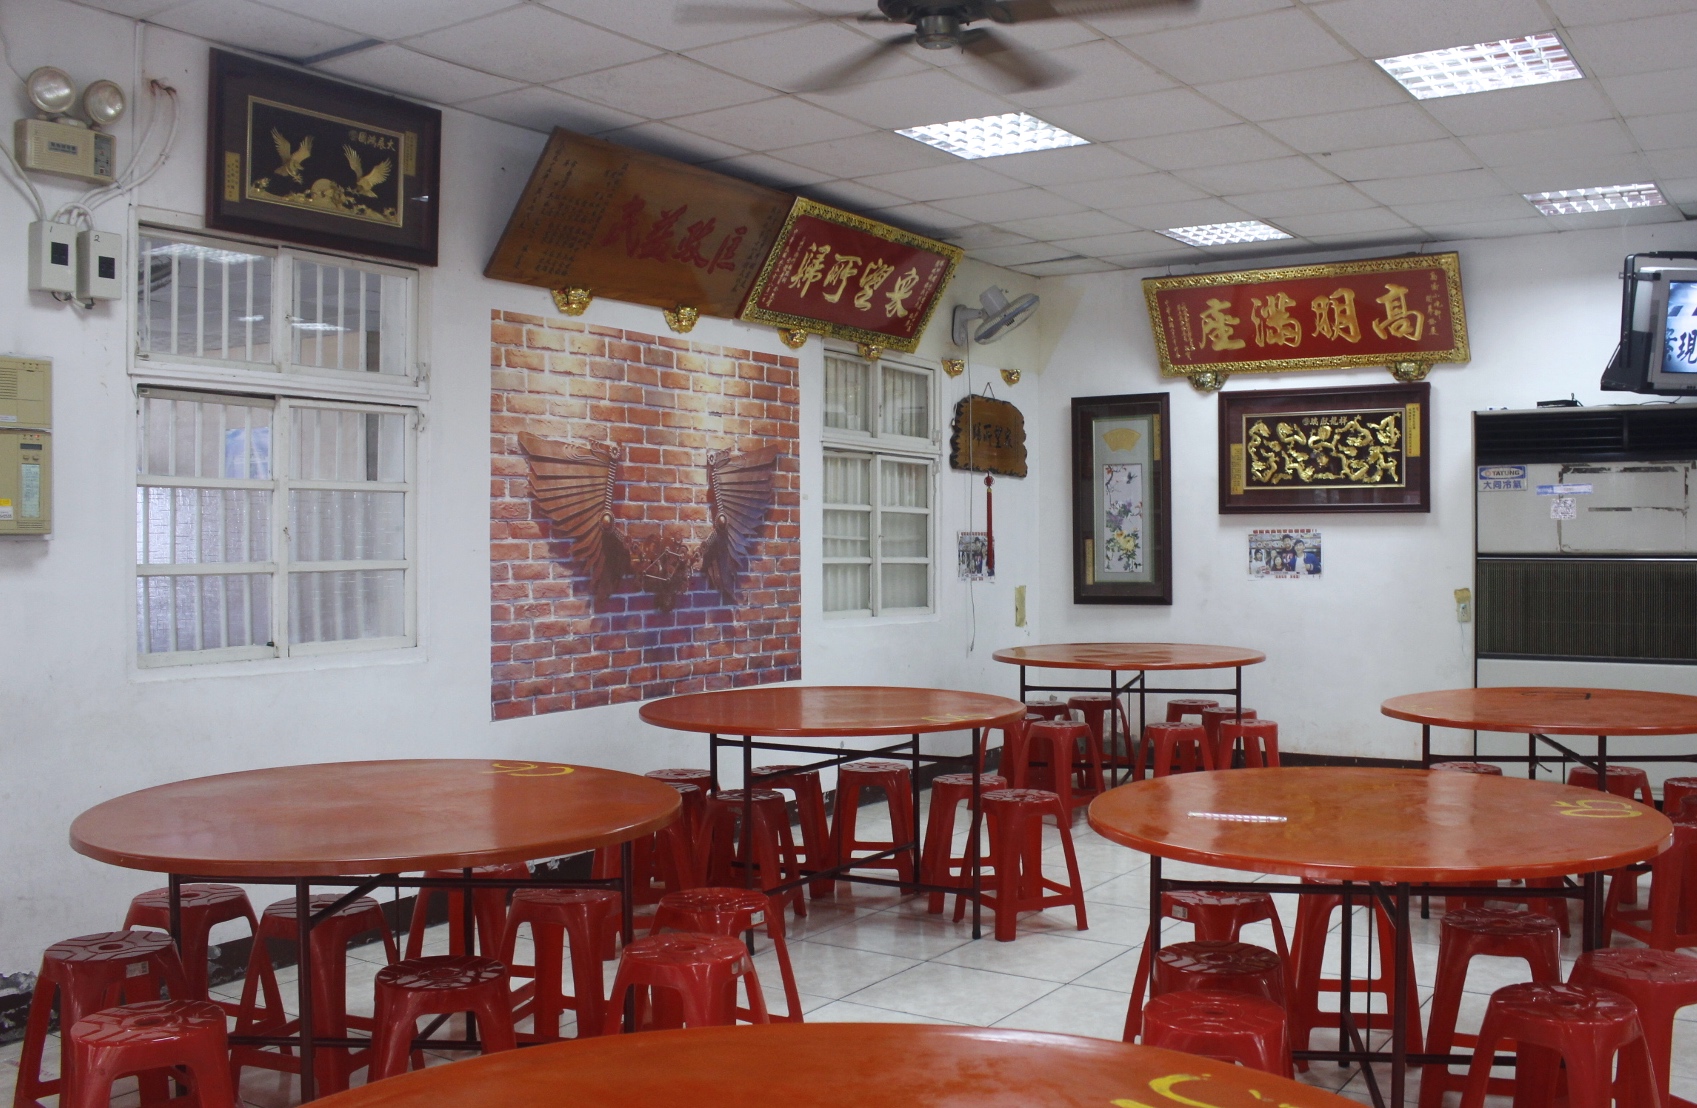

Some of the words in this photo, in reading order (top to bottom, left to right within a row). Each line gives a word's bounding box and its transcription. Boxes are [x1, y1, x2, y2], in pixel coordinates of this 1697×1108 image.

[1492, 469, 1520, 477] TATUNG
[1483, 479, 1522, 490] 大同冷氣
